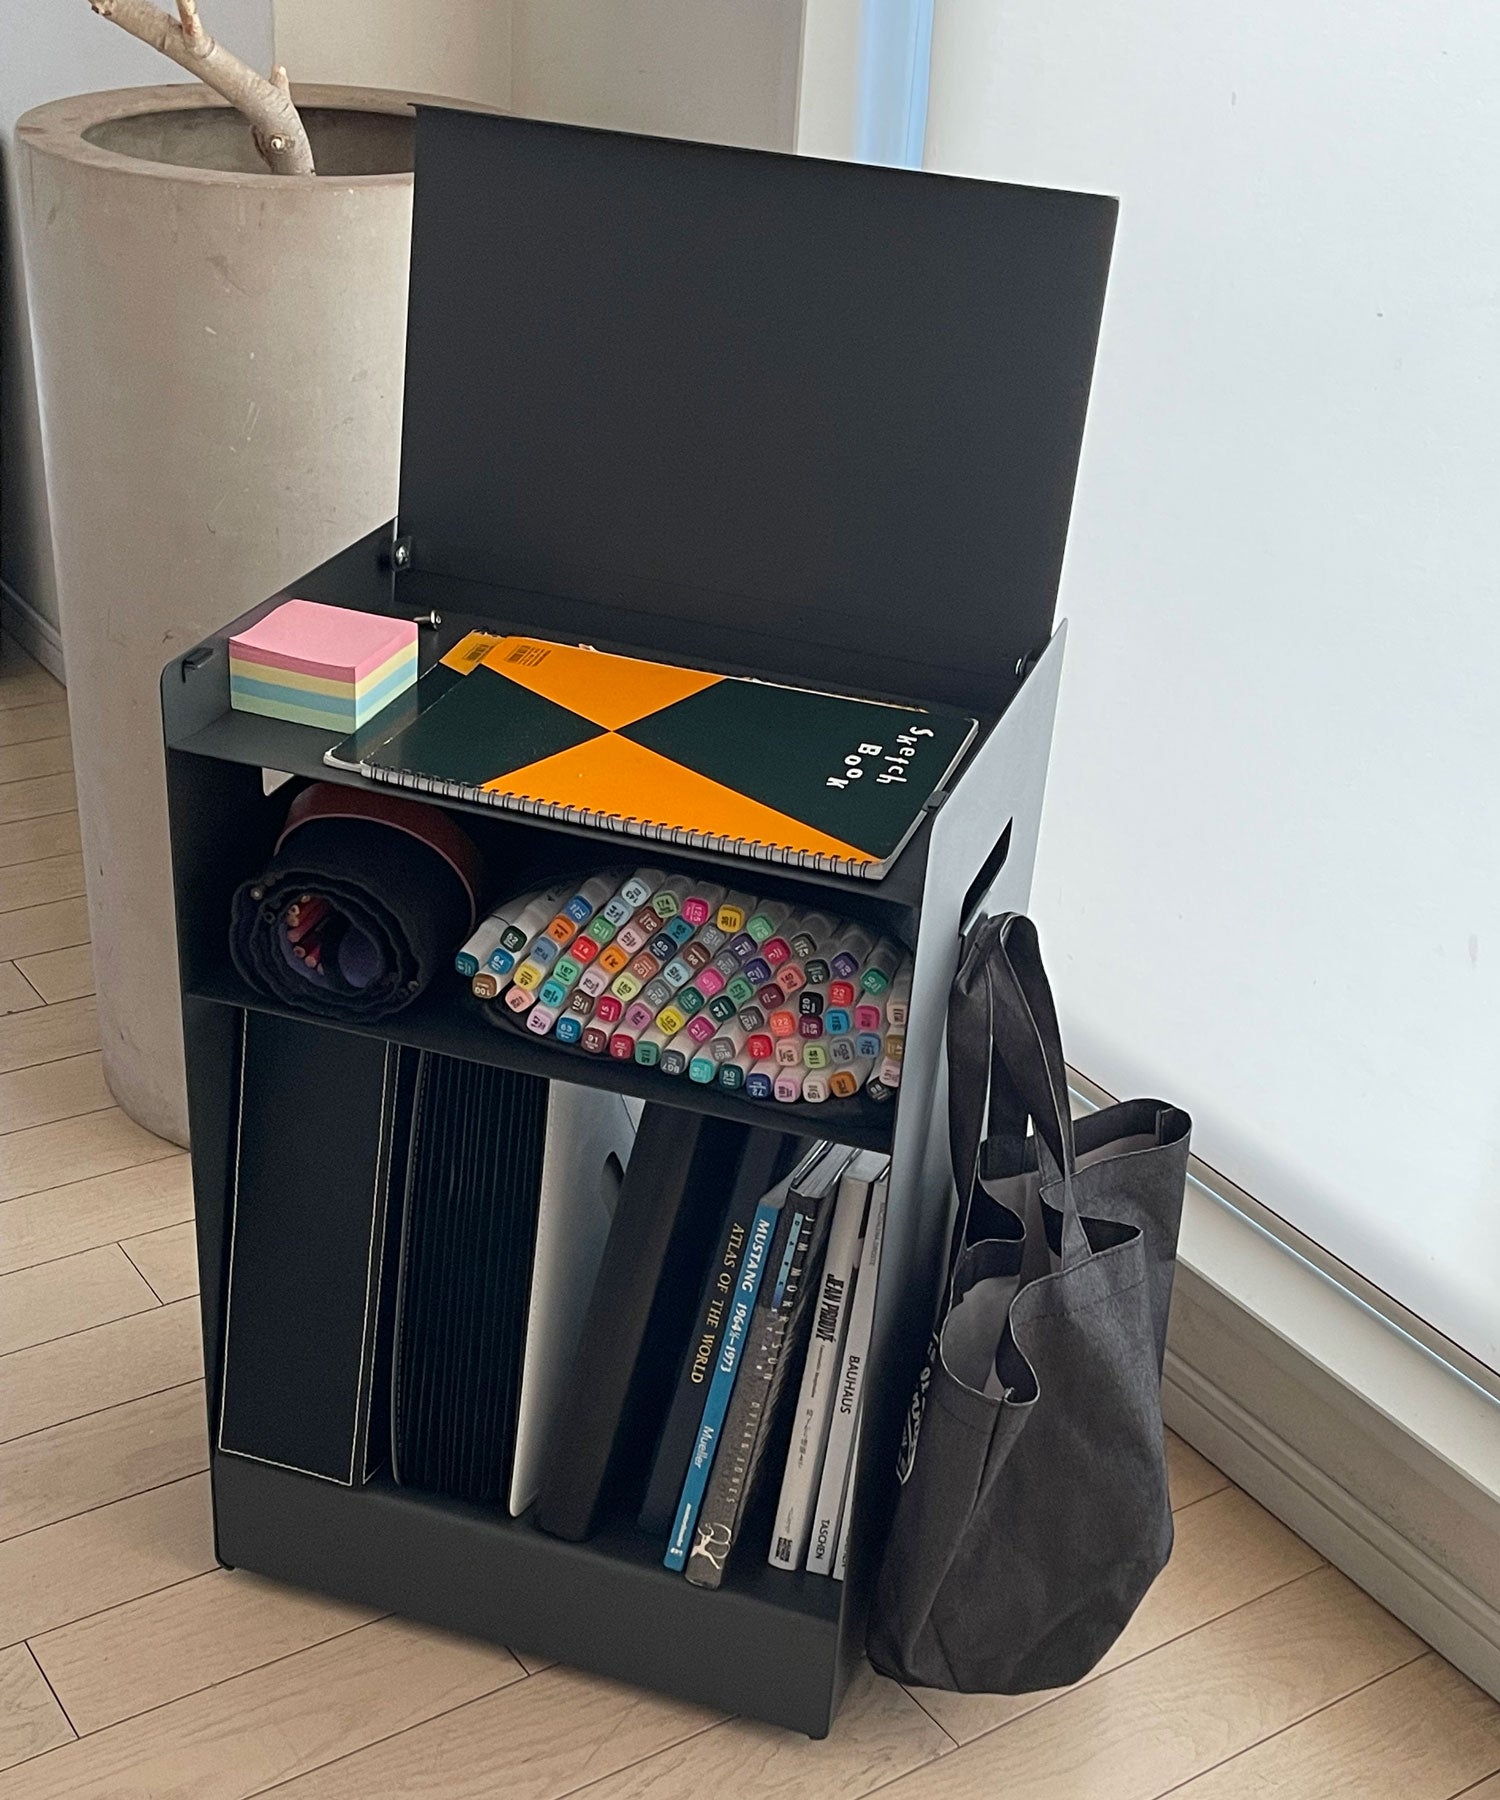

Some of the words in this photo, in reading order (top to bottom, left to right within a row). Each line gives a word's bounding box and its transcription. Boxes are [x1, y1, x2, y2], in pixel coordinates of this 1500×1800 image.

[876, 726, 934, 784] Sketch
[826, 743, 883, 789] Book
[625, 890, 638, 903] 143
[657, 898, 670, 908] 174
[575, 909, 586, 920] 70
[606, 905, 617, 917] 144
[690, 906, 702, 922] 125
[593, 923, 602, 933] 47
[621, 931, 632, 943] 137
[578, 944, 589, 953] 14
[656, 940, 668, 951] 69
[799, 948, 809, 957] 42
[494, 955, 504, 966] 64
[633, 963, 649, 978] 103
[746, 971, 758, 982] 73
[840, 966, 851, 976] 82
[812, 975, 824, 983] 43
[475, 987, 490, 996] 100
[832, 987, 845, 996] 22
[572, 995, 583, 1011] 102
[687, 993, 696, 1005] 55
[600, 1005, 610, 1016] 15
[802, 997, 811, 1014] 120
[712, 1006, 724, 1018] 54
[531, 1016, 540, 1027] 147
[664, 1015, 677, 1028] 123
[772, 1018, 789, 1026] 122
[588, 1034, 598, 1043] 91
[752, 1088, 764, 1097] 72
[796, 1215, 815, 1253] JIM
[724, 1222, 745, 1268] ATLAS
[741, 1218, 771, 1292] MUSTANG
[716, 1272, 732, 1294] OF
[823, 1273, 844, 1303] JEAN
[705, 1300, 726, 1329] THE
[763, 1267, 803, 1381] MORRISON
[690, 1334, 716, 1384] WORLD
[840, 1356, 860, 1414] BAUHAUS
[696, 1425, 714, 1468] Mueller
[725, 1457, 747, 1504] JONES
[814, 1518, 831, 1560] TASCHEN
